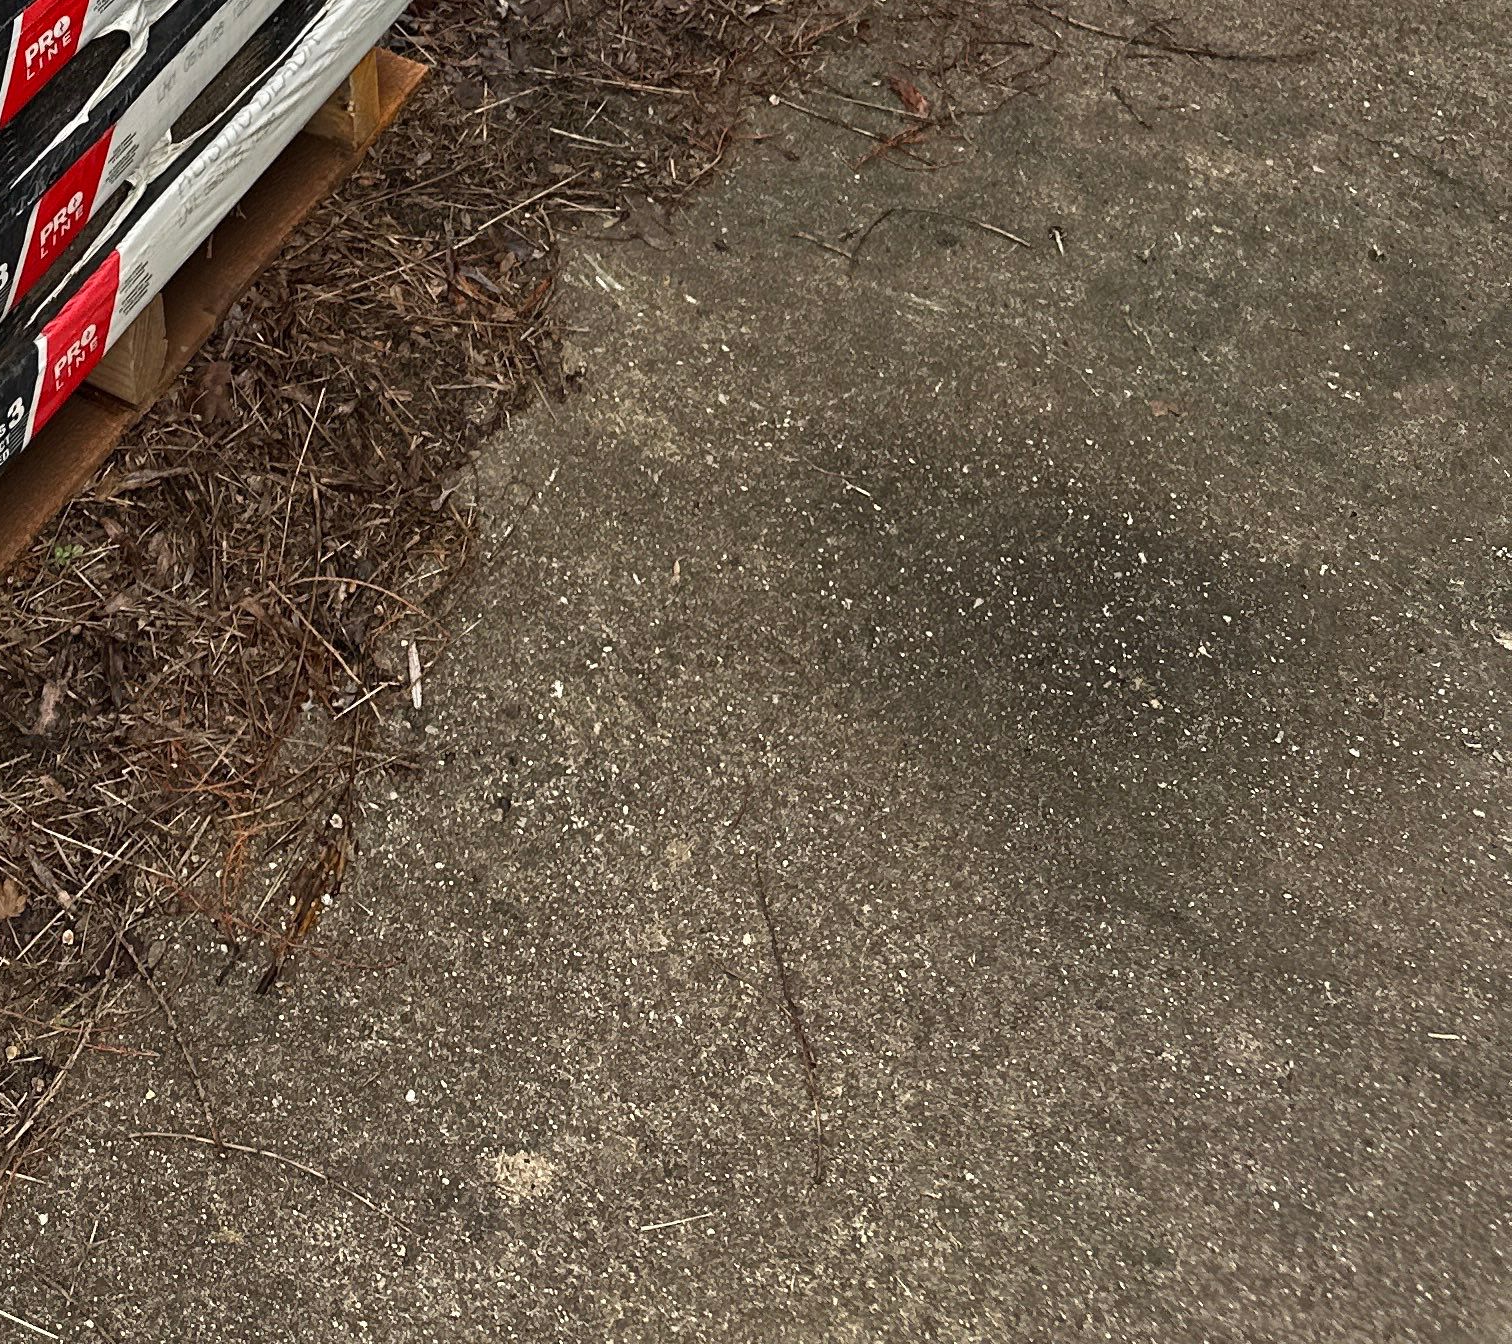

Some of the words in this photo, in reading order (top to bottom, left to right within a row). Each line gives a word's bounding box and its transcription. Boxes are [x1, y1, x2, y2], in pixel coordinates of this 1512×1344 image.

[25, 15, 71, 66] PRO
[25, 32, 72, 80] LINE
[54, 323, 98, 378] PRO
[55, 340, 99, 392] LINE
[6, 397, 24, 431] 3
